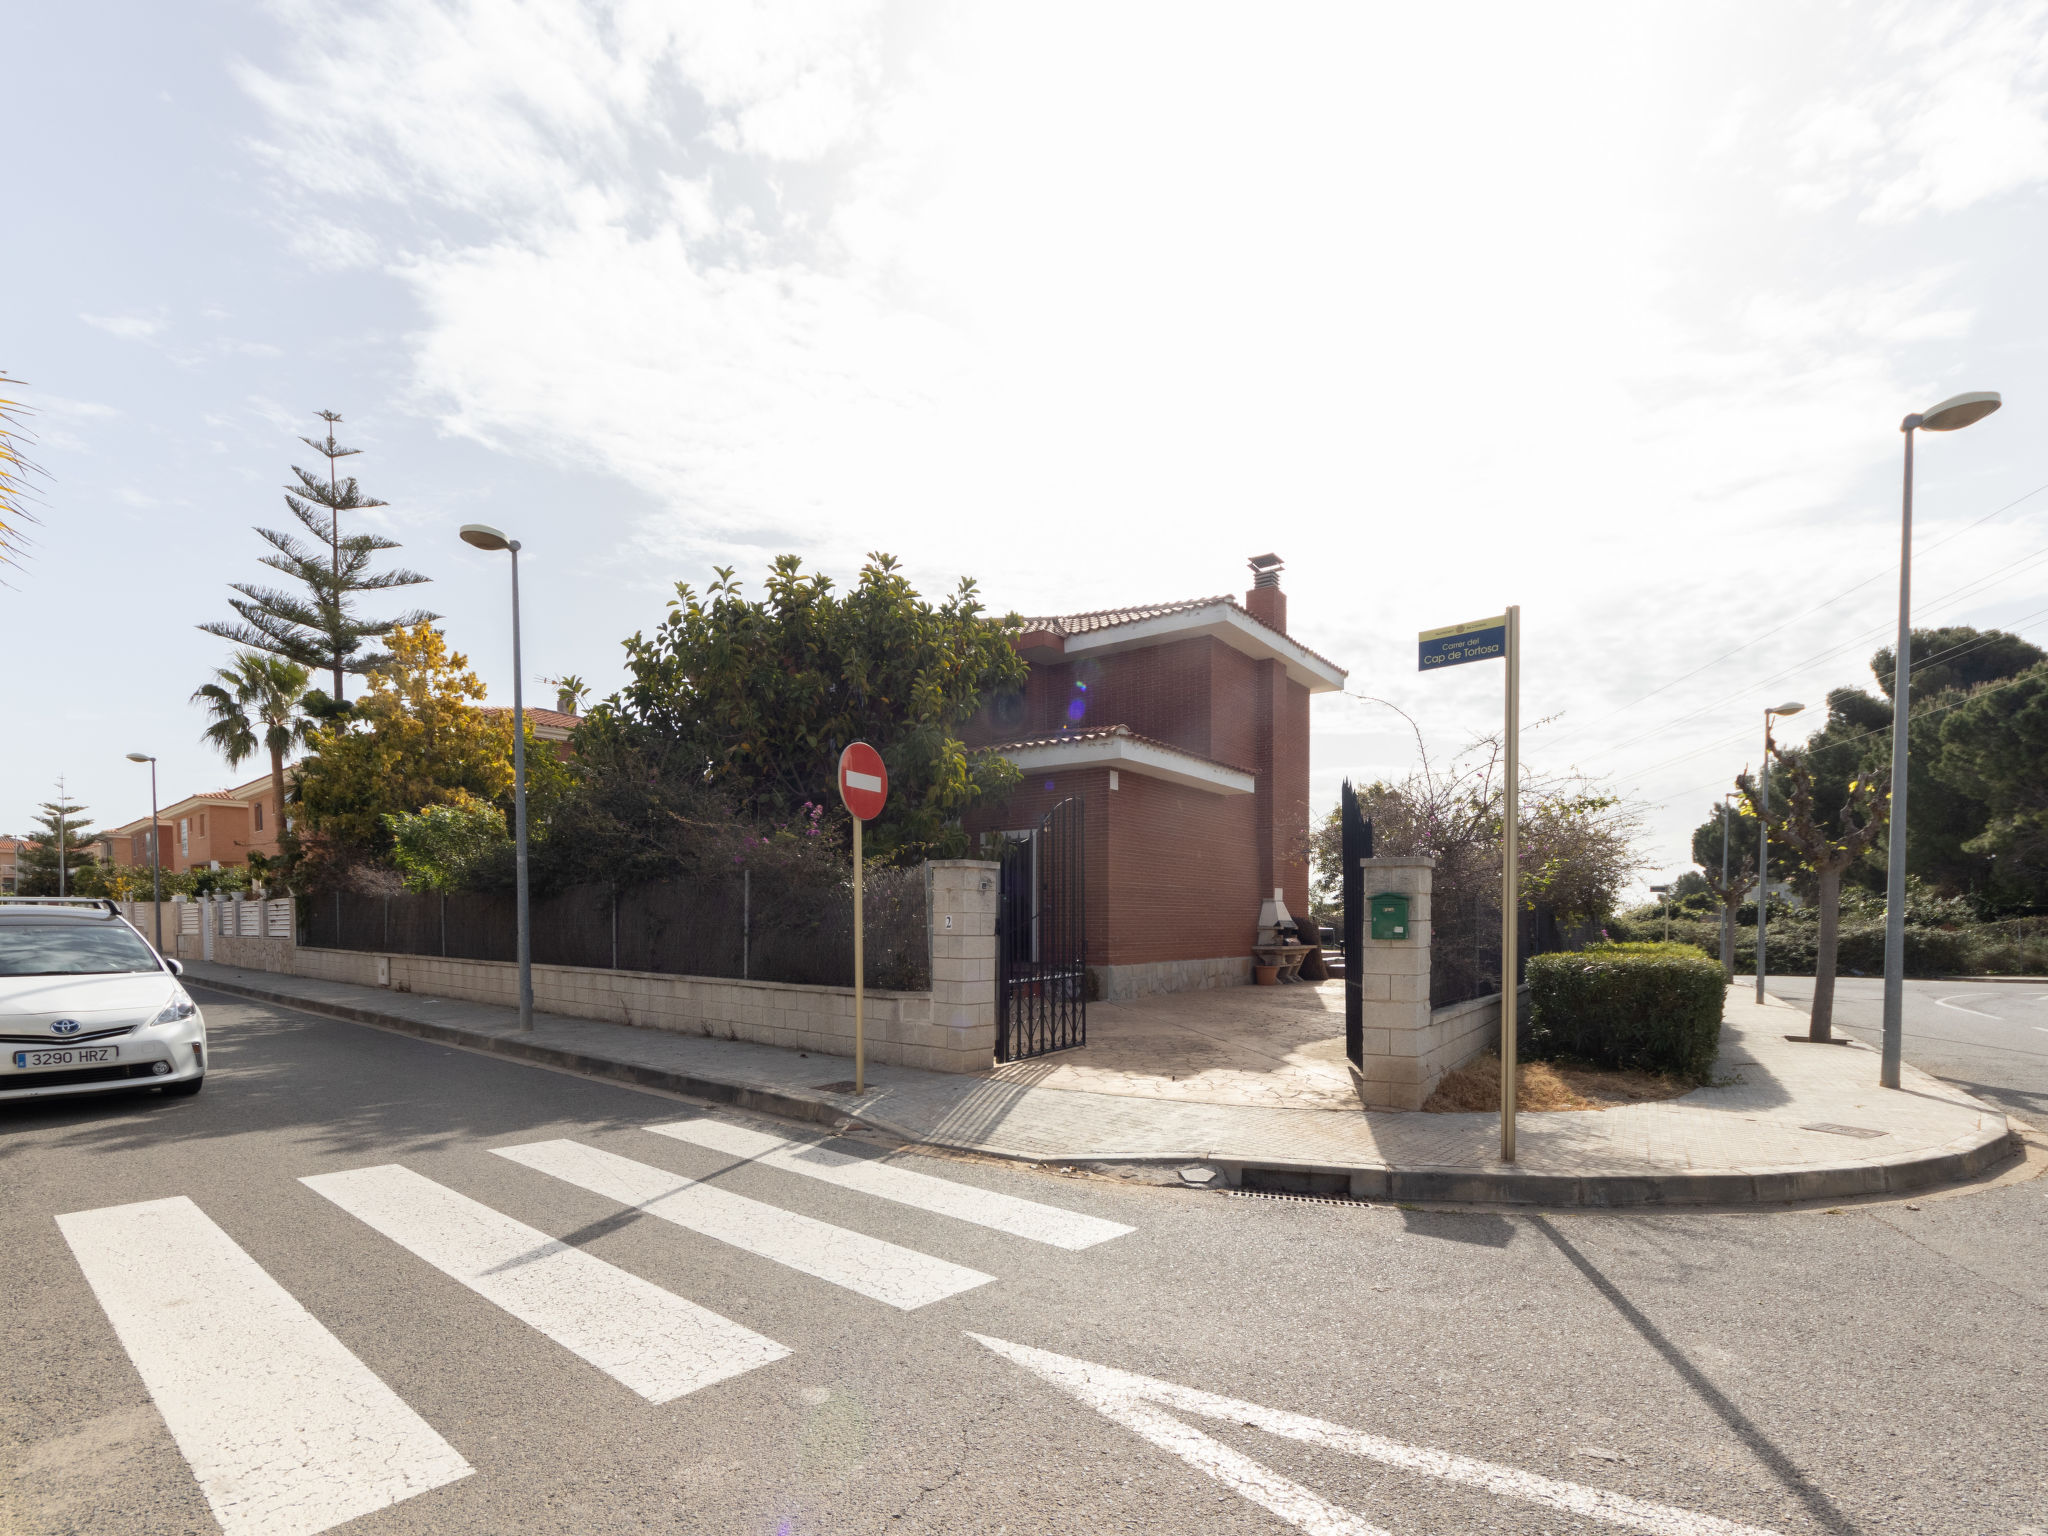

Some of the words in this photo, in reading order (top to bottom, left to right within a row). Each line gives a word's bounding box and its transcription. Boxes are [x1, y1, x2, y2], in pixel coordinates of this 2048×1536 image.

[1442, 641, 1465, 651] Carrer
[1467, 637, 1480, 646] del
[1423, 654, 1446, 665] Cap
[1447, 651, 1462, 660] de
[1463, 644, 1499, 657] Tortosa
[946, 916, 952, 928] 2
[32, 1052, 73, 1066] 3290
[79, 1049, 108, 1062] HRZ
